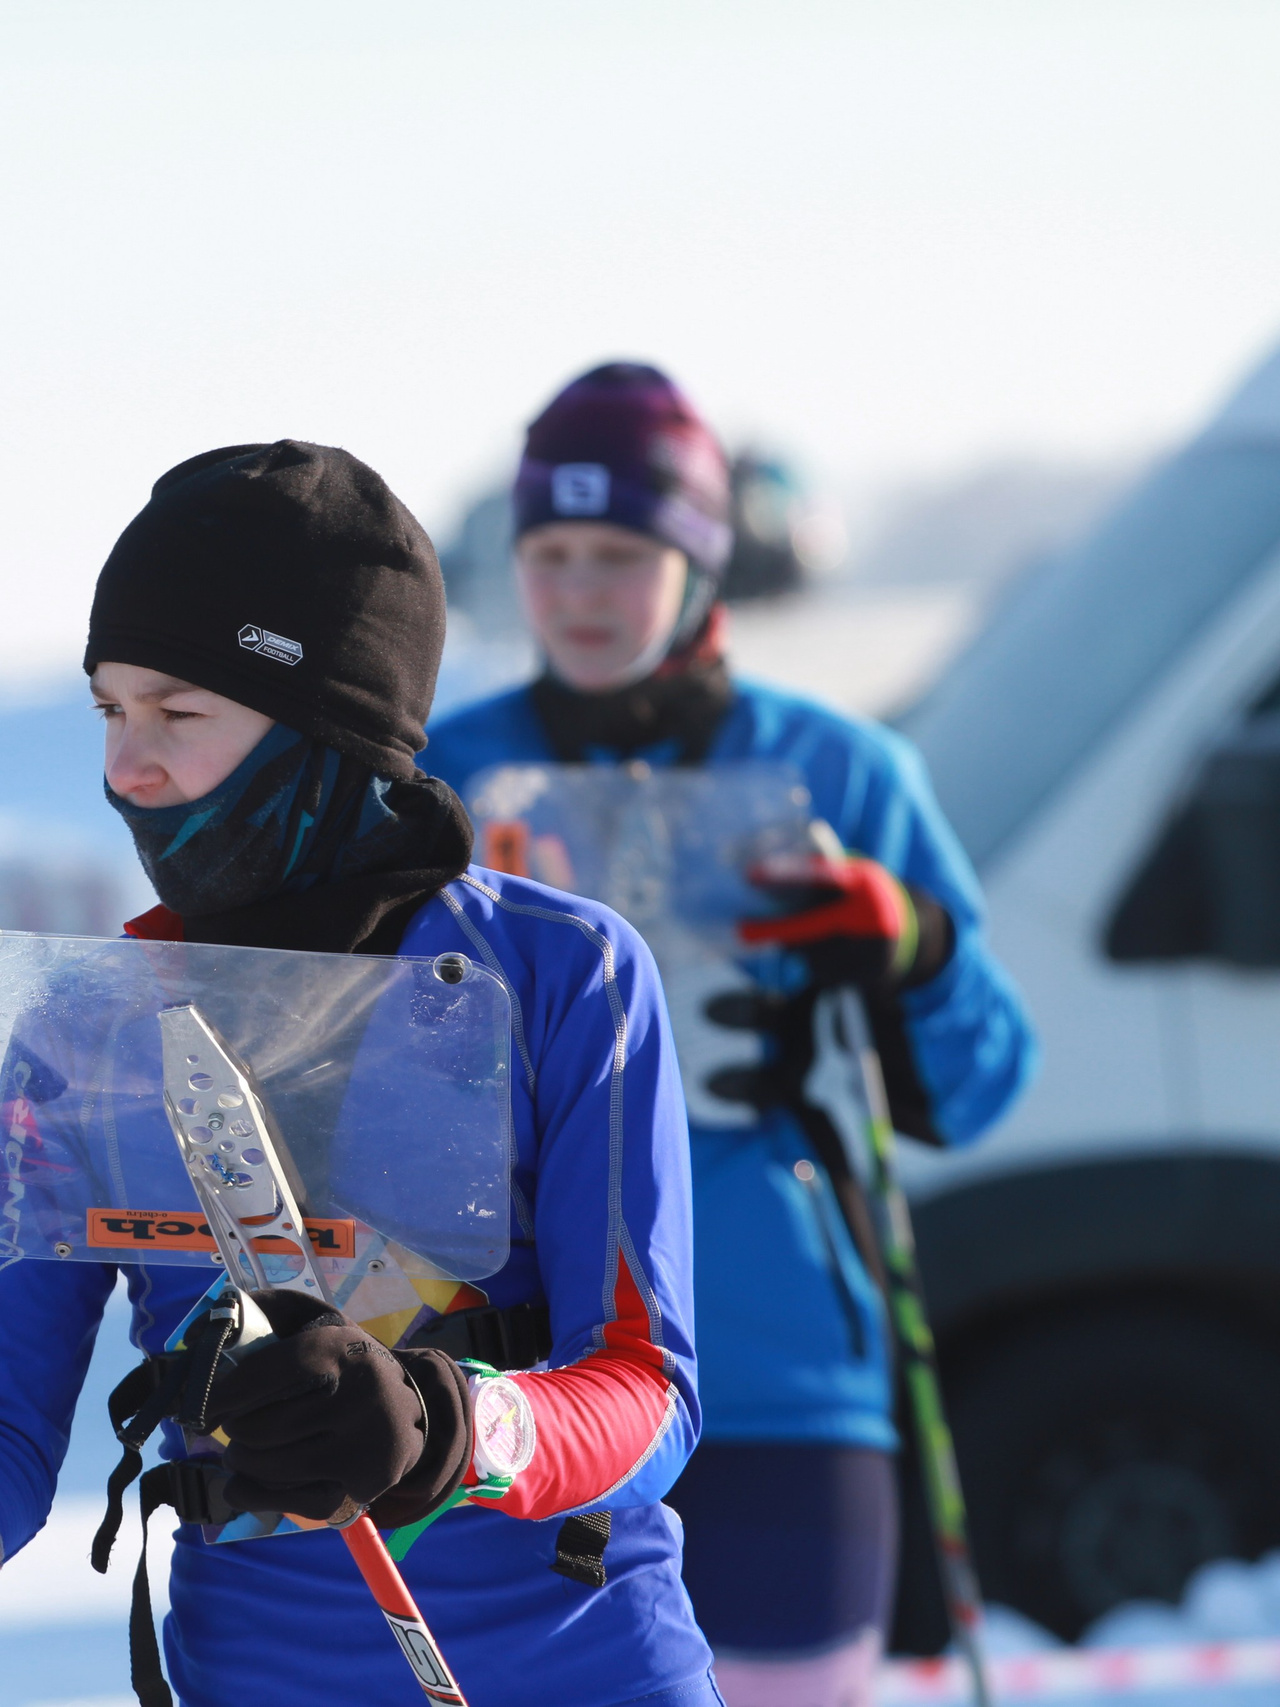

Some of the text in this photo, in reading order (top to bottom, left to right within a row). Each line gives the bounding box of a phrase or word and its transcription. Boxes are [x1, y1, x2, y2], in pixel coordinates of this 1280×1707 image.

[266, 636, 299, 651] DEMIX
[263, 645, 294, 662] FOOTBALL
[126, 1210, 168, 1218] o-chel.ru
[100, 1217, 341, 1249] bch
